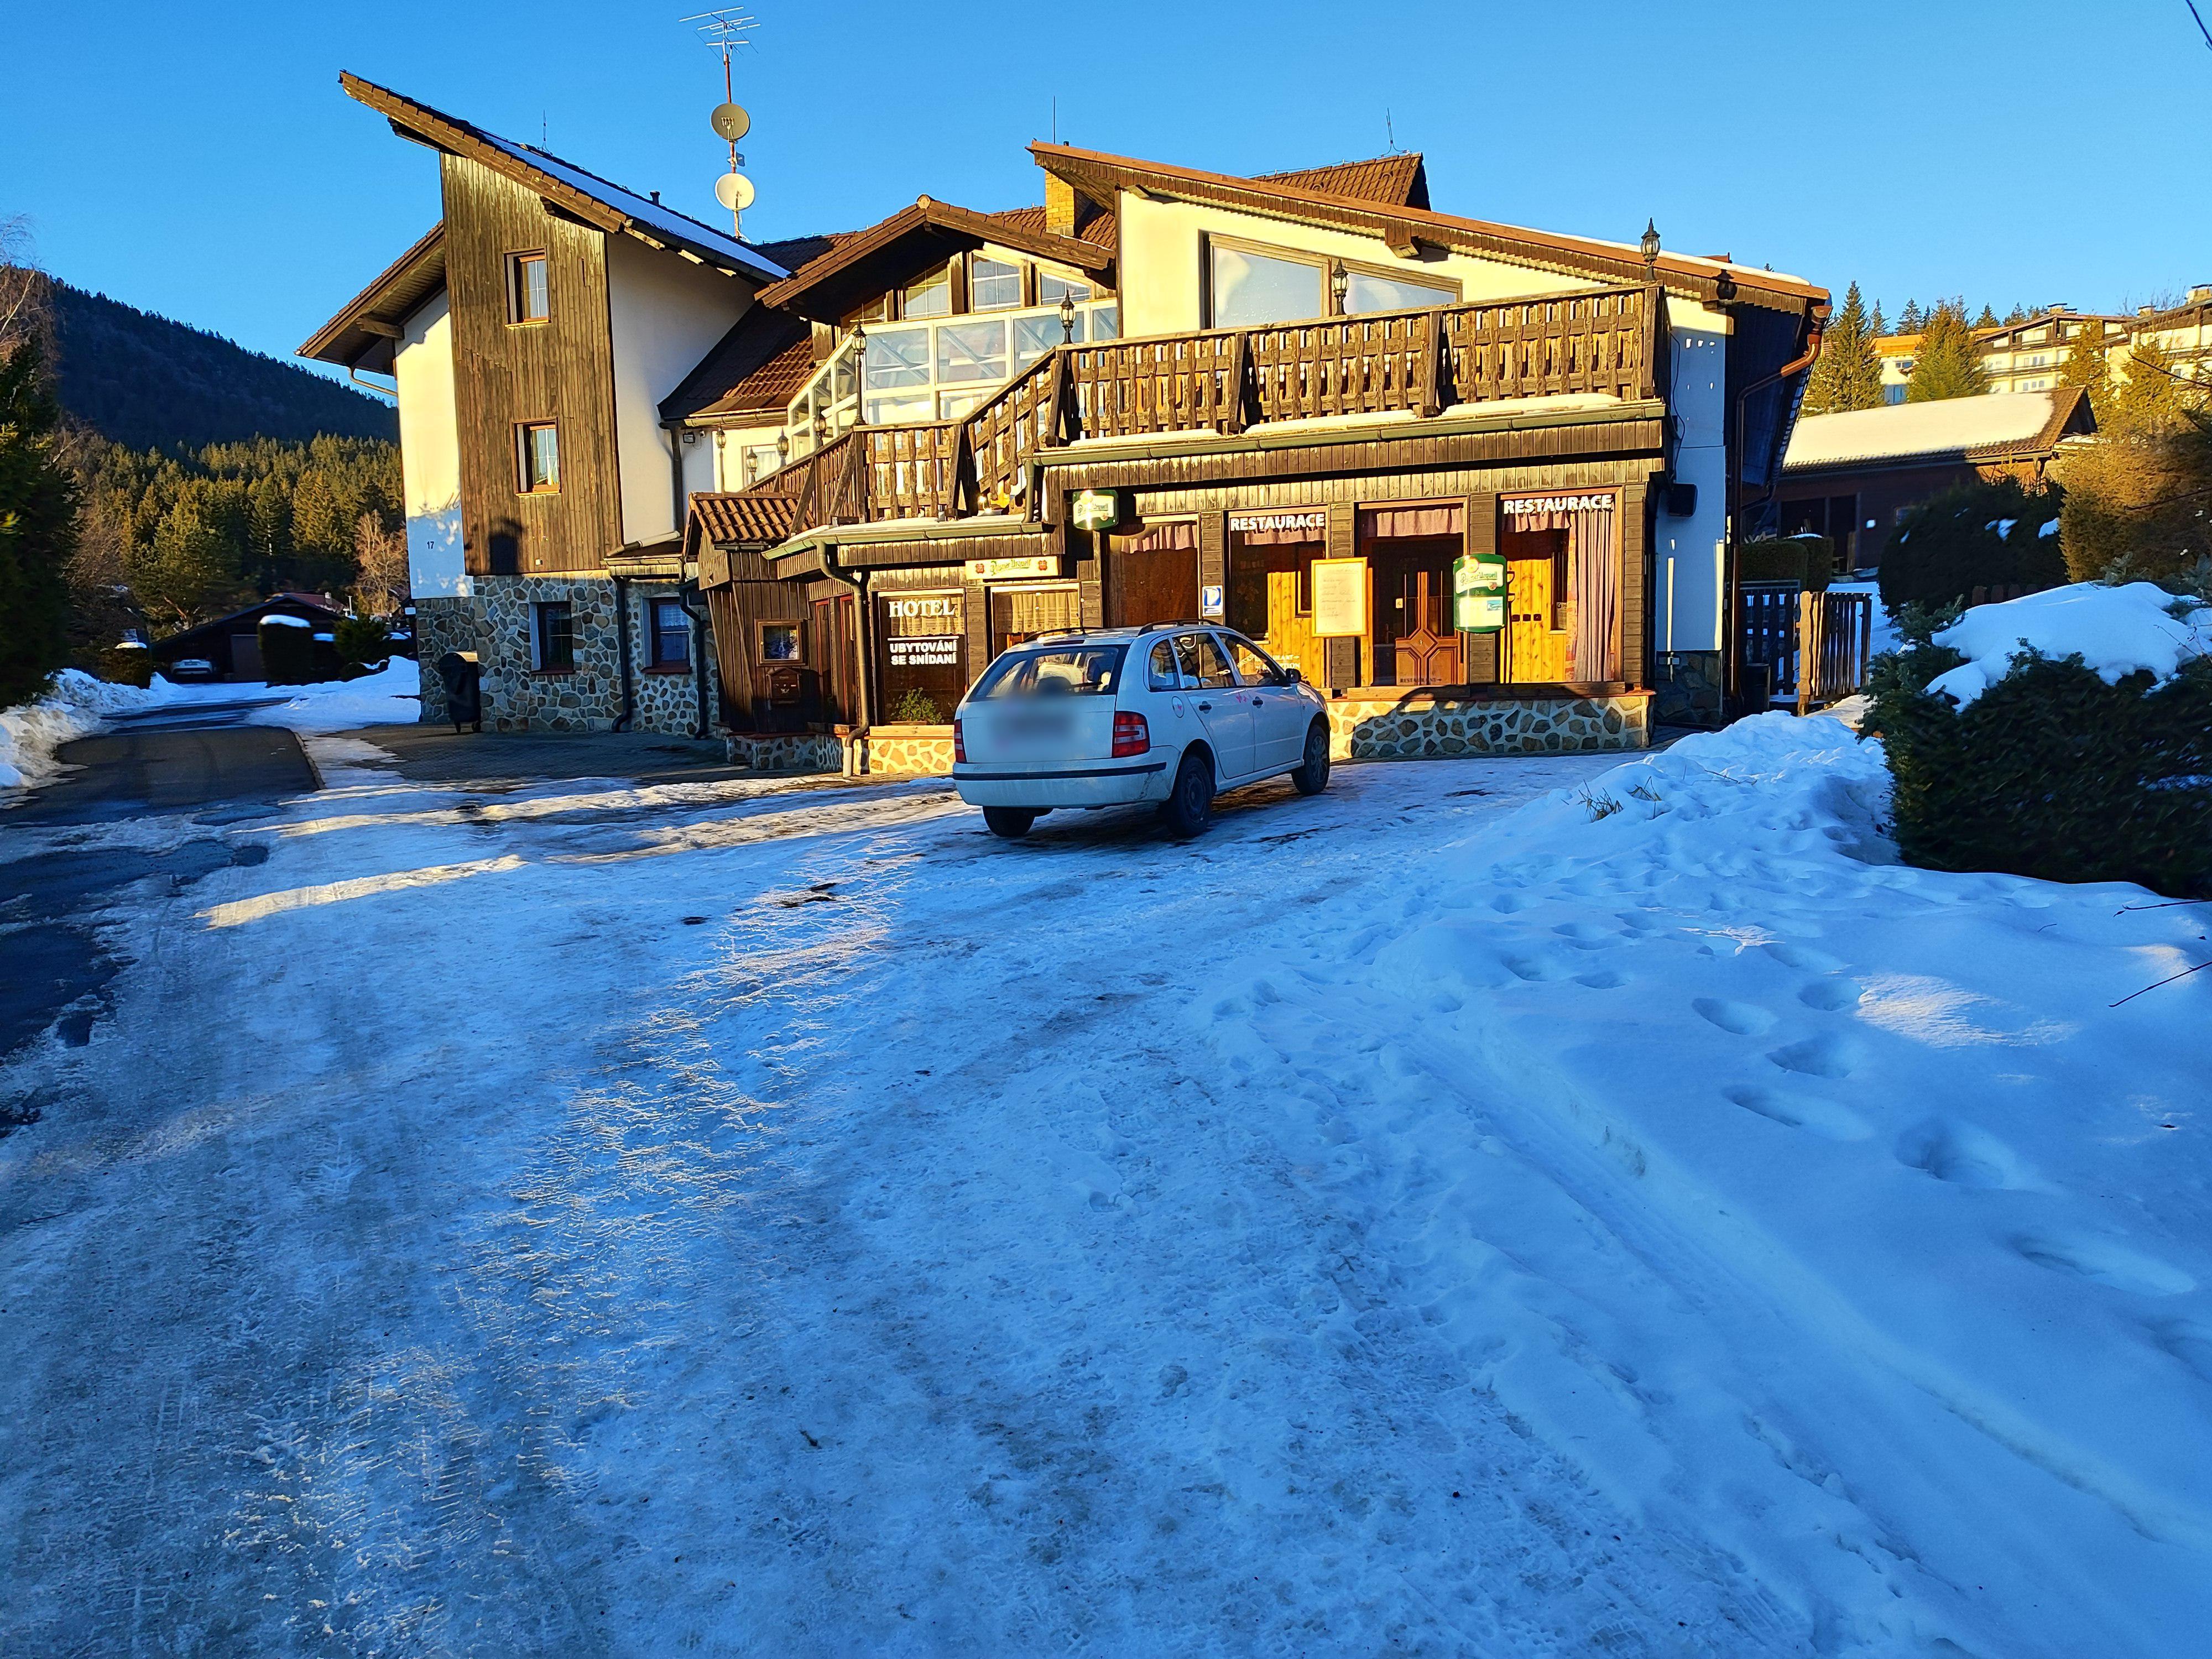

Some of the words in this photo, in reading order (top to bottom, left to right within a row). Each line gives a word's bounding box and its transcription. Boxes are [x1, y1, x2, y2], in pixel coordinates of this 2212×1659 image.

[1504, 494, 1612, 514] RESTAURACE
[1230, 513, 1325, 531] RESTAURACE
[427, 541, 434, 549] 17
[888, 599, 955, 618] HOTEL
[889, 639, 957, 653] UBYTOVÁNÍ
[891, 655, 906, 665] SE
[909, 651, 957, 665] SNÍDANÍ
